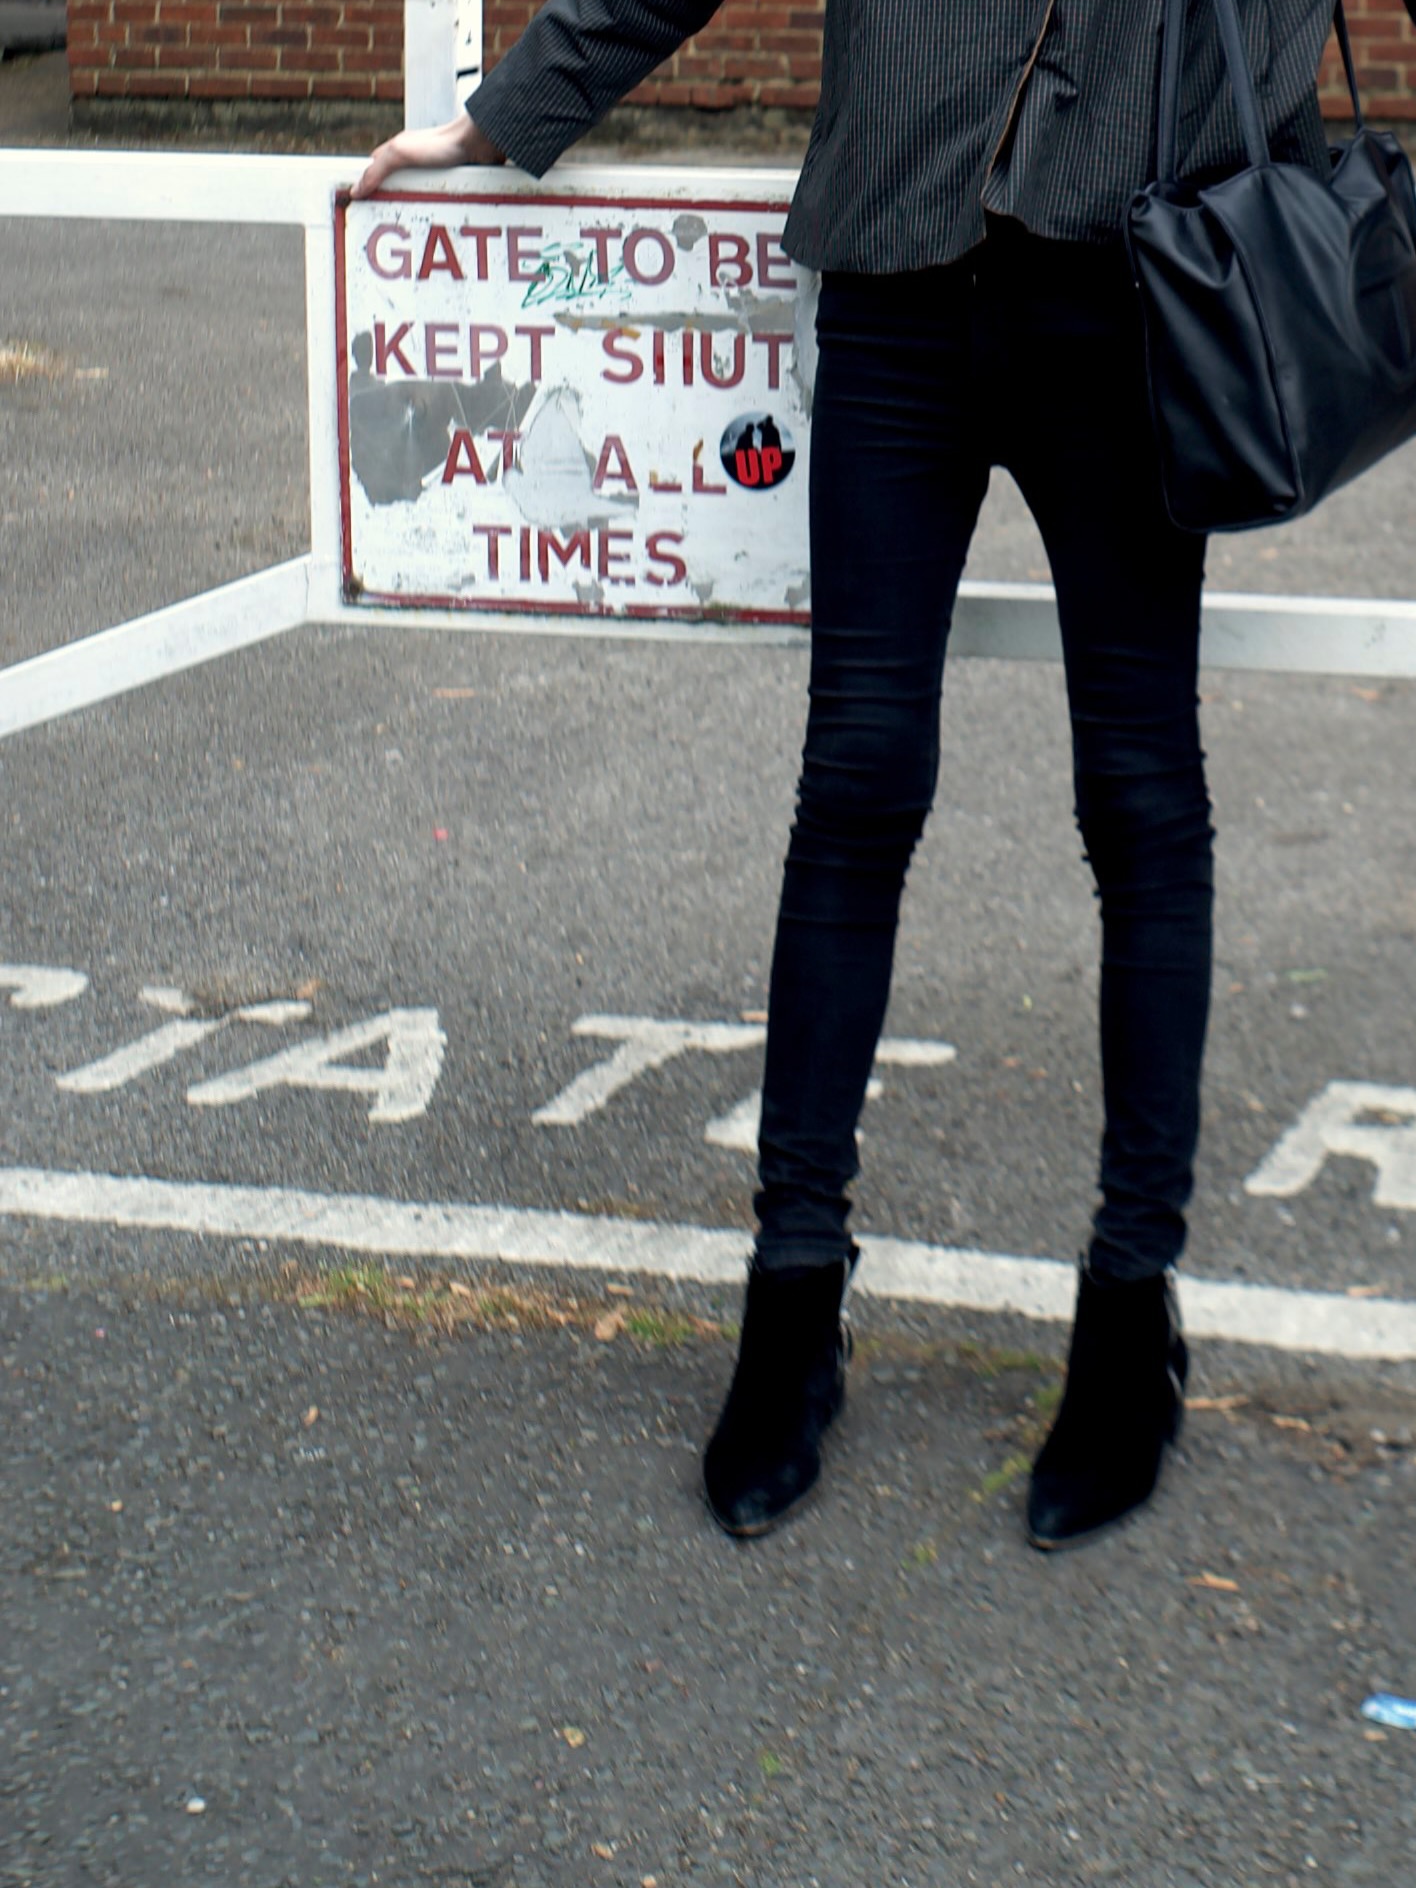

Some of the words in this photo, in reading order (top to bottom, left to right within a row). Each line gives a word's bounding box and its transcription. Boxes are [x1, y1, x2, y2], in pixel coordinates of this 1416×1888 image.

[365, 223, 544, 284] GATE
[580, 226, 677, 286] TO
[708, 231, 798, 290] BE
[373, 320, 556, 381] KEPT
[601, 327, 795, 391] SHUT
[441, 429, 521, 485] AT
[735, 445, 783, 487] UP
[472, 523, 688, 587] TIMES
